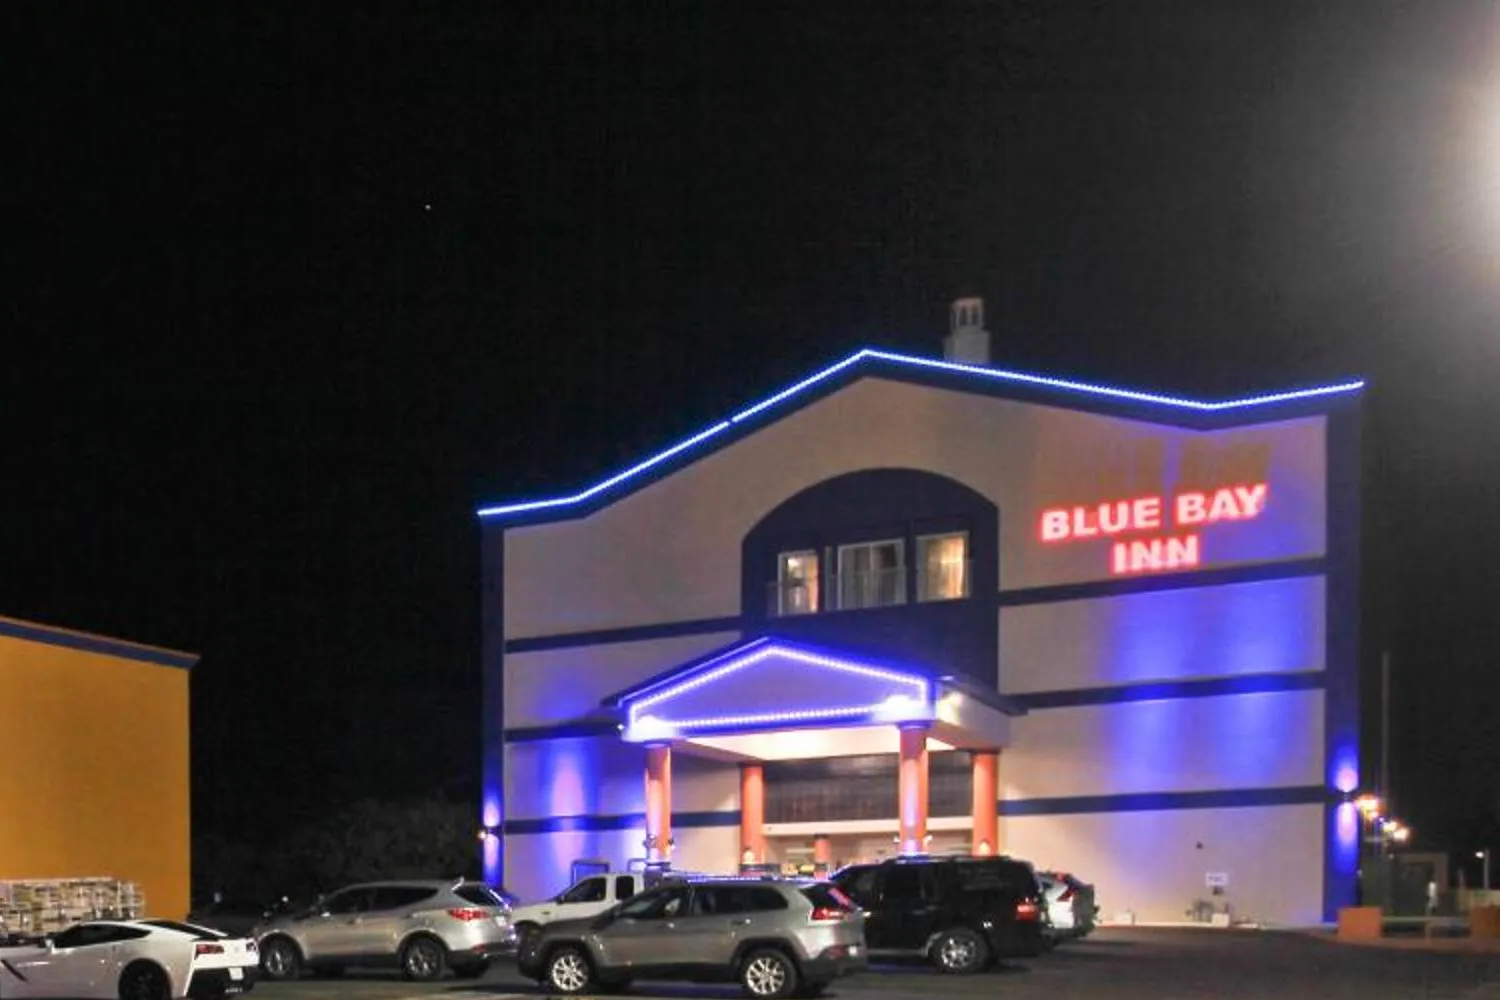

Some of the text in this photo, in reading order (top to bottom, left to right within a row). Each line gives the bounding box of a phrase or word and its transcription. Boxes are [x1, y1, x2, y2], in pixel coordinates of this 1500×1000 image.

[1040, 483, 1268, 543] BLUE BAY
[1112, 535, 1199, 575] INN
